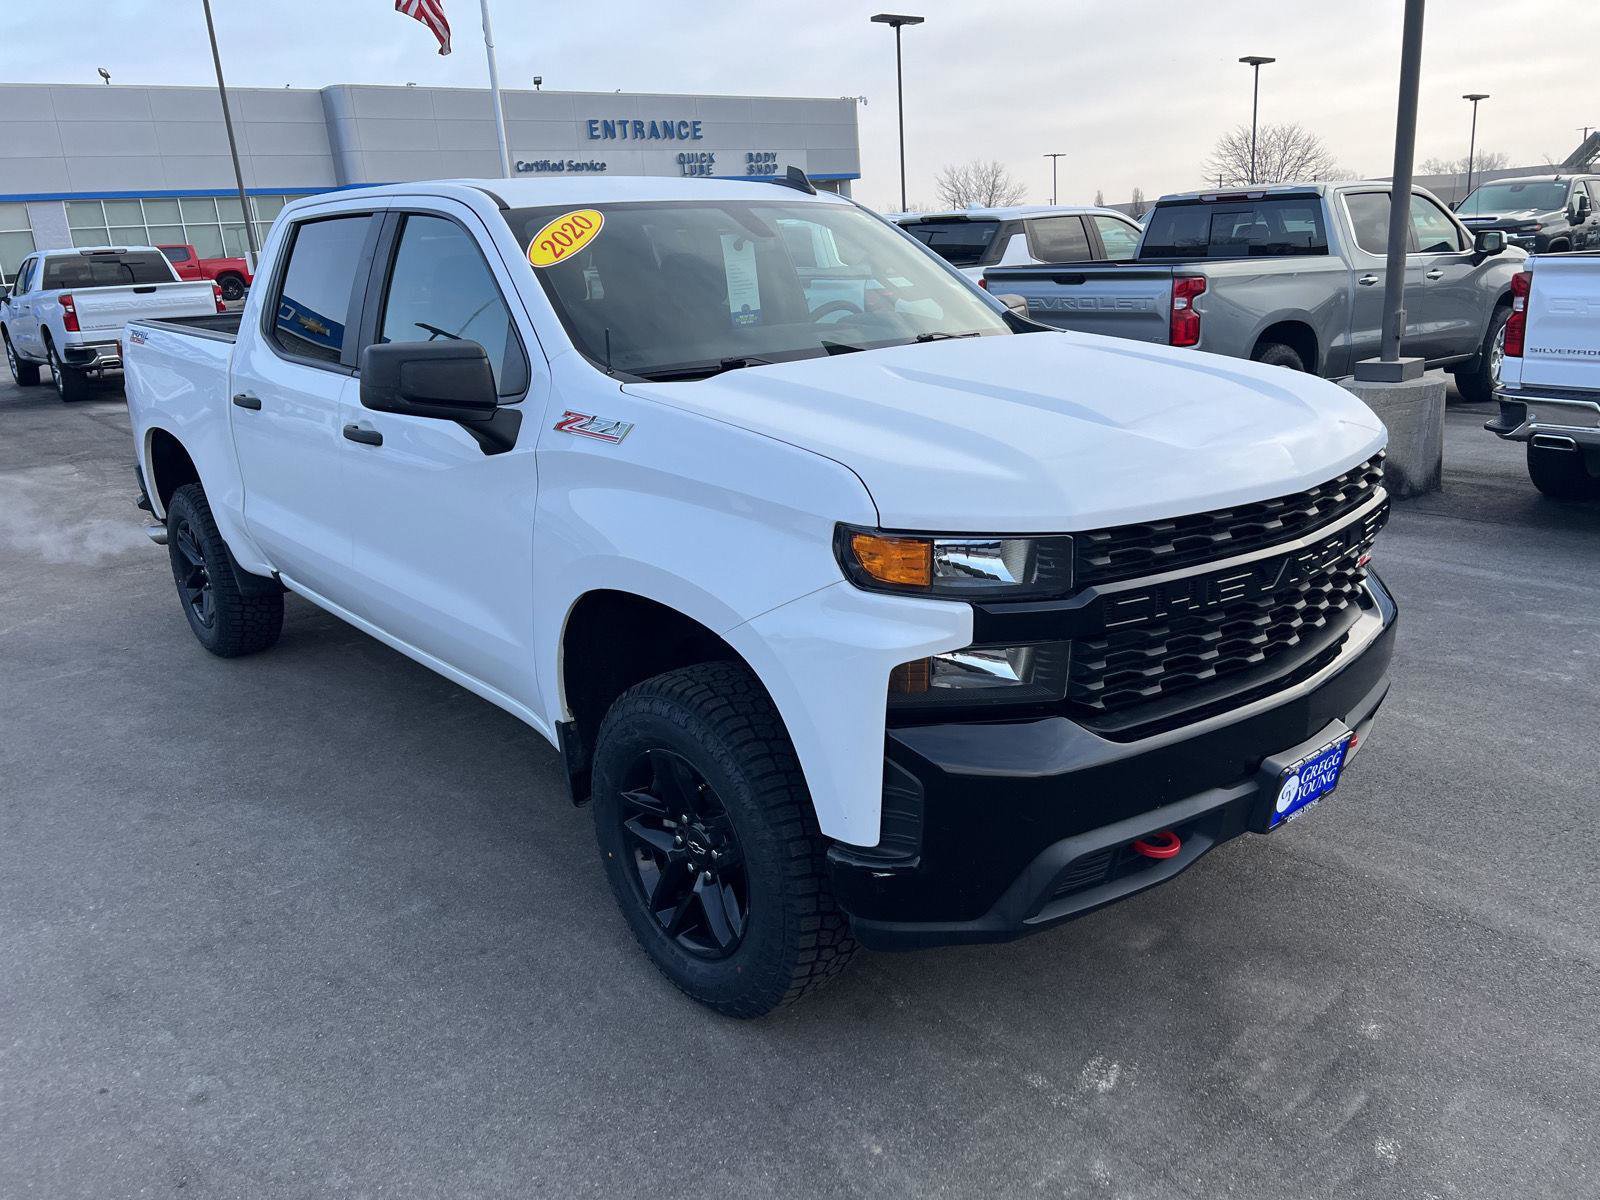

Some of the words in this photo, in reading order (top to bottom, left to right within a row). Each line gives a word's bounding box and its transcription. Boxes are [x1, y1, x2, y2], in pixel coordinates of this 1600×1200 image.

[587, 119, 703, 140] ENTRANCE
[677, 152, 716, 165] QUICK
[746, 152, 778, 164] BODY
[516, 160, 565, 172] Certified
[566, 160, 607, 172] Service
[682, 164, 714, 176] LUBE
[746, 163, 779, 176] SHOP
[540, 215, 593, 259] 2020
[130, 329, 149, 340] TRAIL
[1529, 347, 1600, 356] SILVERAD
[553, 410, 635, 445] Z71
[1301, 750, 1342, 784] GREGG
[1295, 766, 1338, 802] YOUNG
